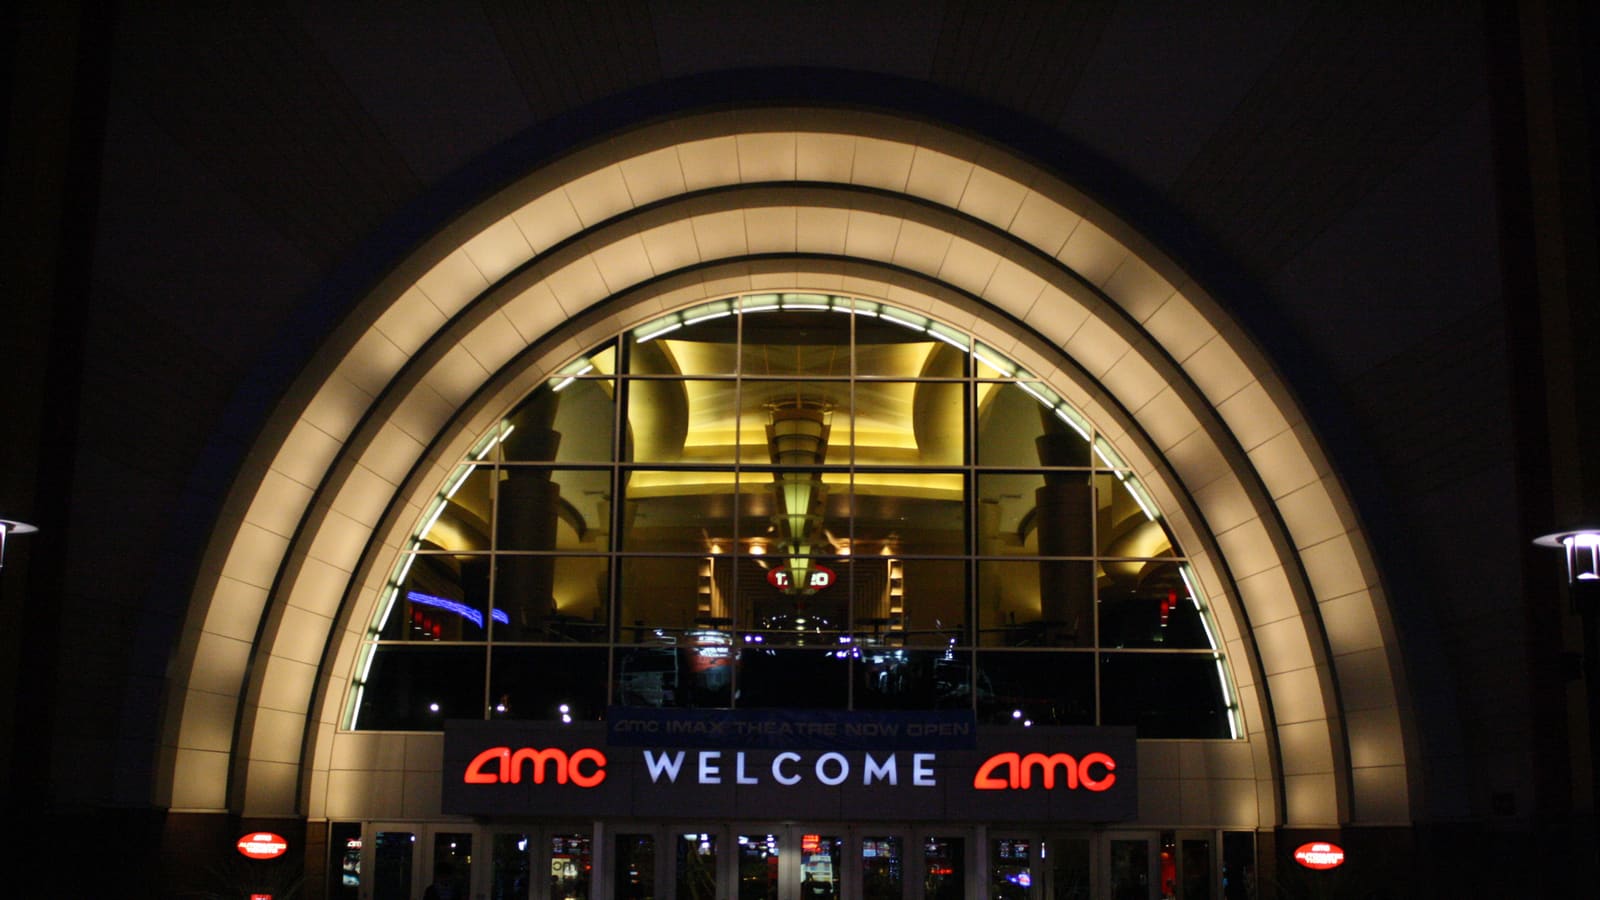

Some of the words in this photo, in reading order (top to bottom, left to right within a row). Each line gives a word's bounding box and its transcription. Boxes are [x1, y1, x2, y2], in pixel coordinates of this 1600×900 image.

[666, 720, 721, 735] IMAX
[735, 721, 837, 736] THEATRE
[844, 722, 900, 737] NOW
[906, 722, 970, 737] OPEN
[464, 745, 608, 789] amc
[643, 750, 936, 786] WELCOME
[973, 751, 1118, 792] amc
